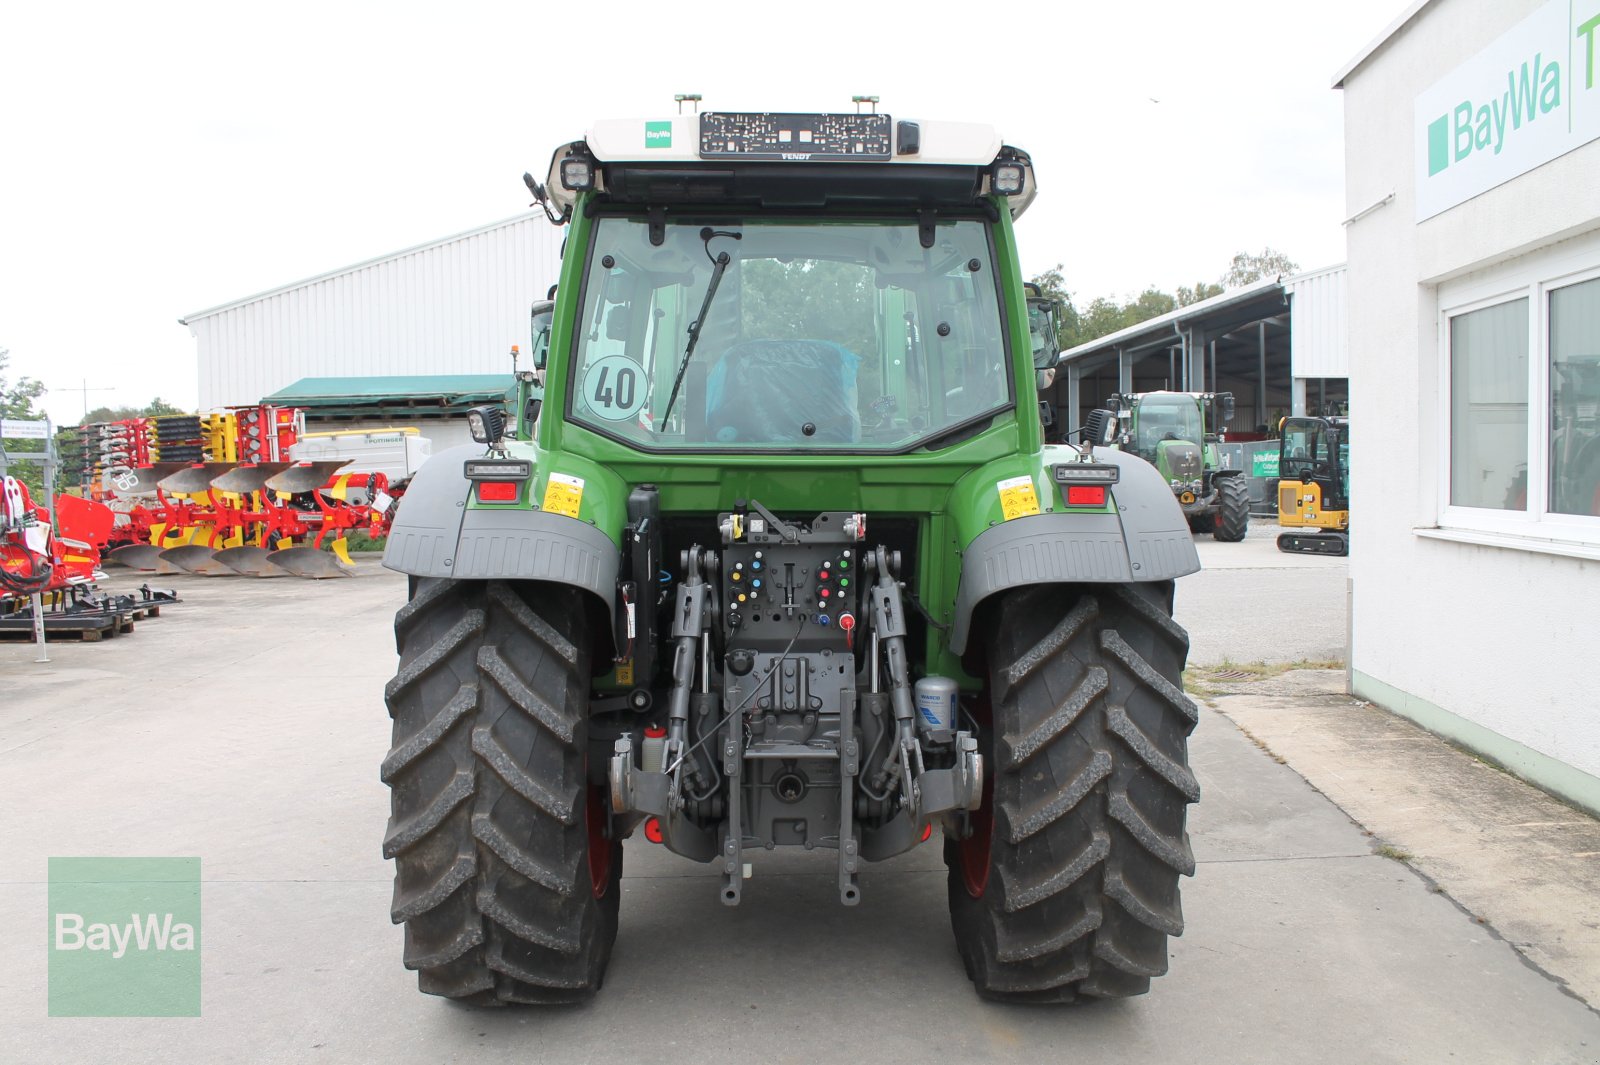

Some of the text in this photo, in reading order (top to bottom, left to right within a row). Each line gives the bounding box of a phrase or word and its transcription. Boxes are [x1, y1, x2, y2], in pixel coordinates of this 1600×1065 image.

[1453, 52, 1561, 163] BayWa
[647, 130, 670, 139] BayWa
[595, 366, 636, 410] 40
